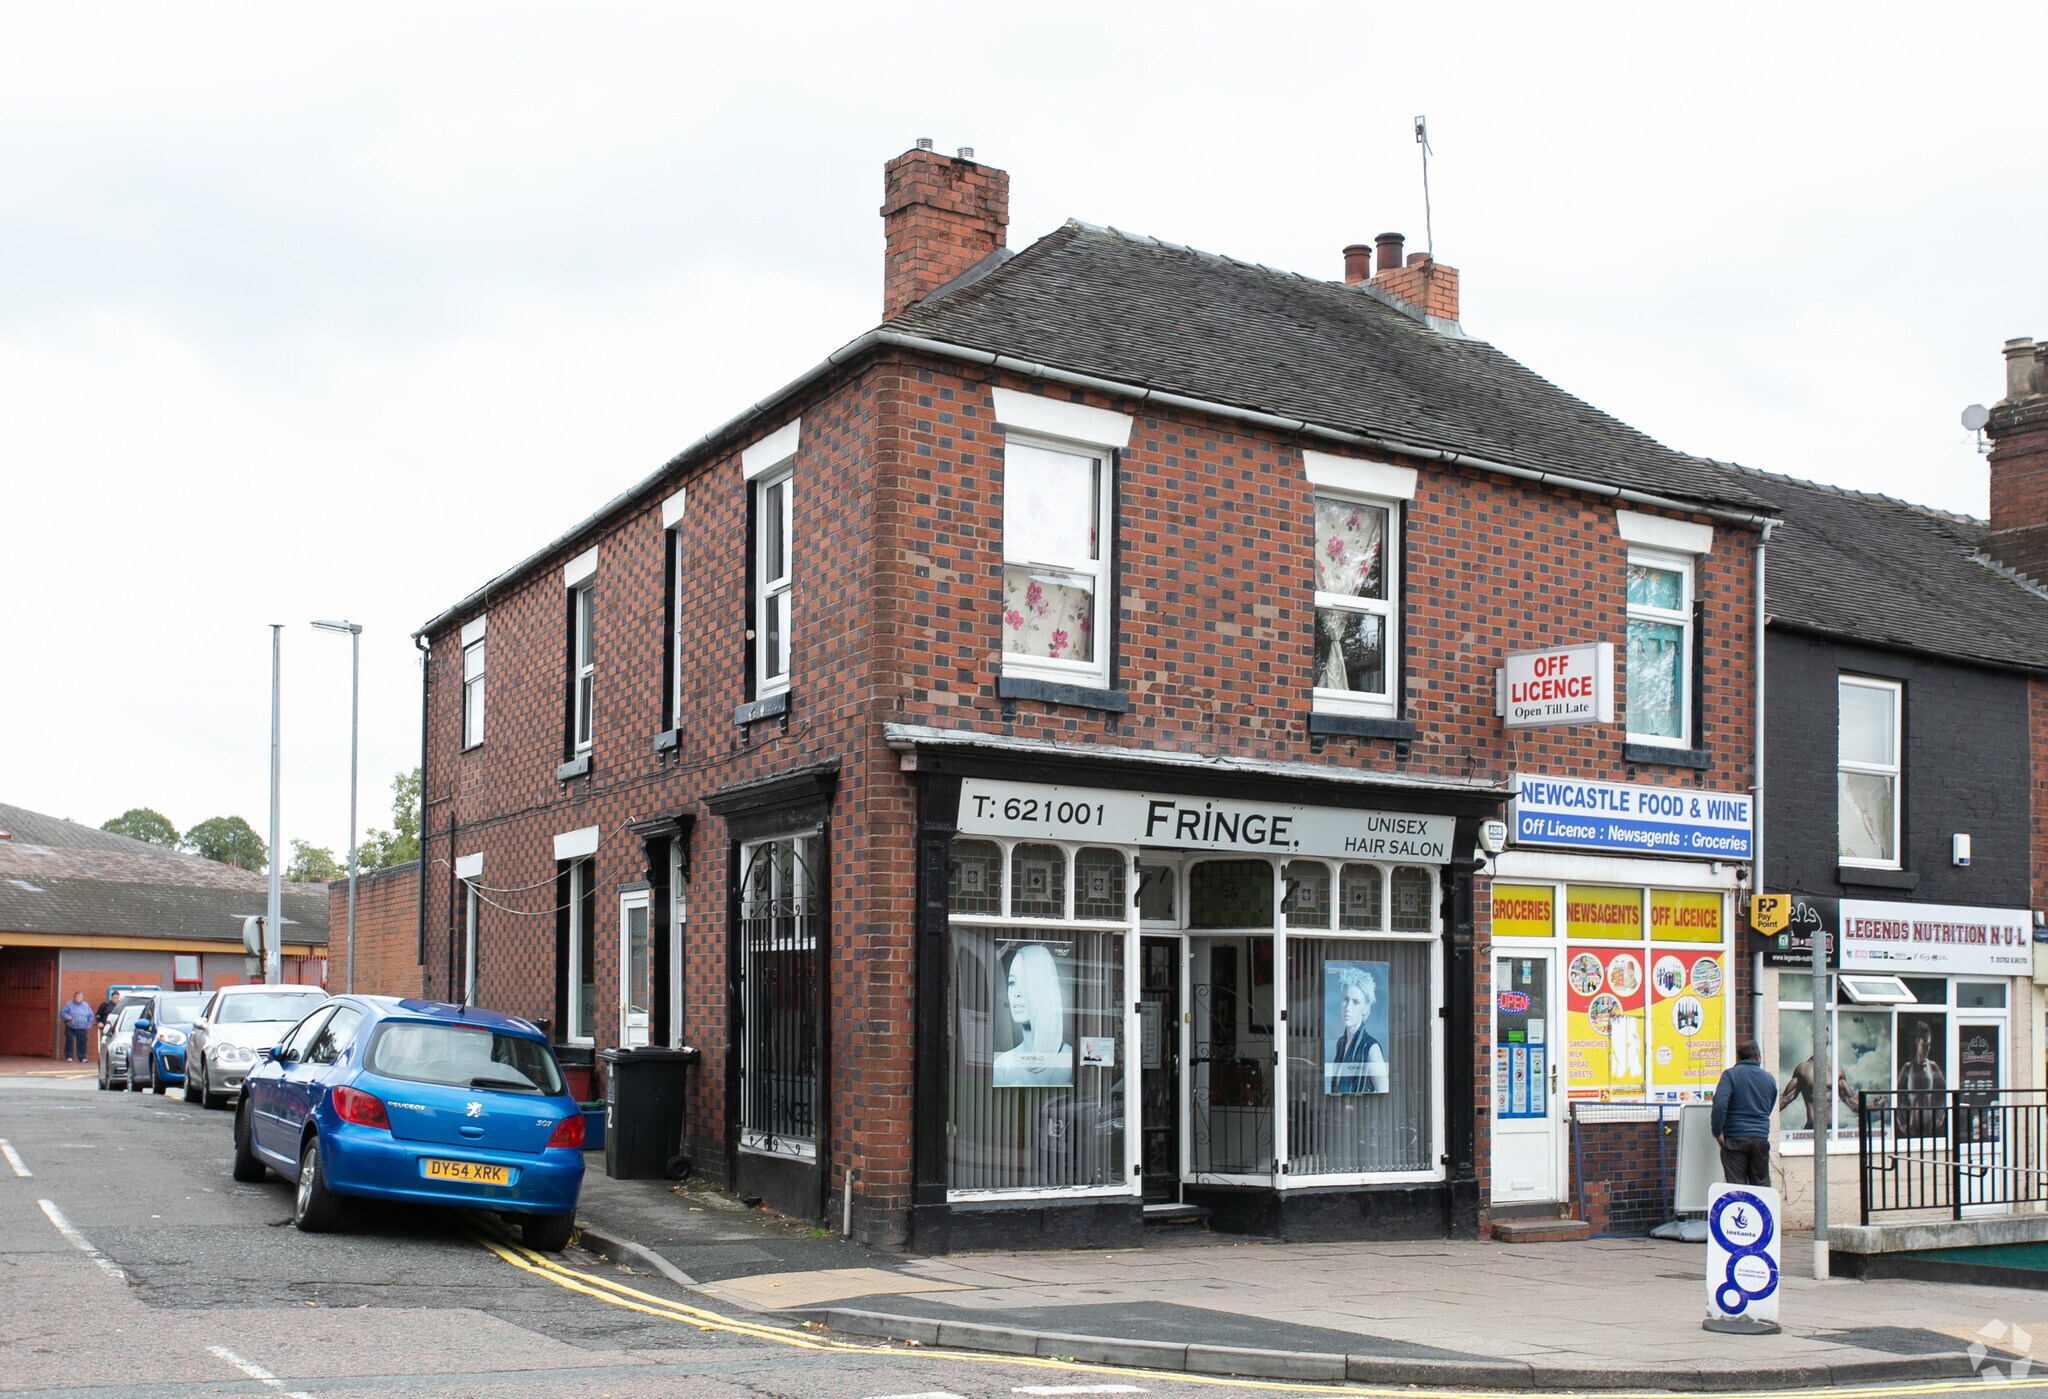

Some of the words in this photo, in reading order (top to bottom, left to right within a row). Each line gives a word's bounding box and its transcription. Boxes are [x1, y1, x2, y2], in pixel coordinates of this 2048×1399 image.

[1534, 655, 1569, 678] OFF
[1511, 676, 1592, 703] LICENCE
[1514, 706, 1542, 719] Open
[1545, 704, 1563, 715] Till
[1566, 702, 1589, 714] Late
[973, 795, 996, 818] T:
[1004, 798, 1104, 826] 621001
[1521, 781, 1630, 812] NEWCASTLE
[1638, 793, 1684, 818] FOOD
[1690, 798, 1701, 818] &
[1707, 800, 1748, 823] WINE
[1367, 817, 1428, 836] UNISEX
[1522, 818, 1545, 835] Off
[1547, 821, 1596, 840] Licence
[1608, 825, 1680, 847] Newsagents
[1692, 832, 1748, 852] Groceries
[1345, 837, 1386, 854] HAIR
[1389, 840, 1444, 858] SALON
[1492, 898, 1550, 922] GROCERIES
[1567, 902, 1639, 926] NEWSAGENTS
[1651, 906, 1671, 927] OFF
[1674, 908, 1718, 929] LICENCE
[1758, 913, 1771, 921] Pay
[1845, 918, 1909, 942] LEGENDS
[1912, 921, 1988, 945] NUTRITION
[1500, 993, 1530, 1011] OPEN
[1569, 1040, 1608, 1048] SANDWICHES
[1569, 1070, 1593, 1078] SWEETS
[387, 1101, 426, 1111] PEUGEOT
[535, 1119, 553, 1127] 307
[607, 1106, 613, 1128] 2
[431, 1160, 469, 1177] DY54
[474, 1165, 502, 1181] XRK
